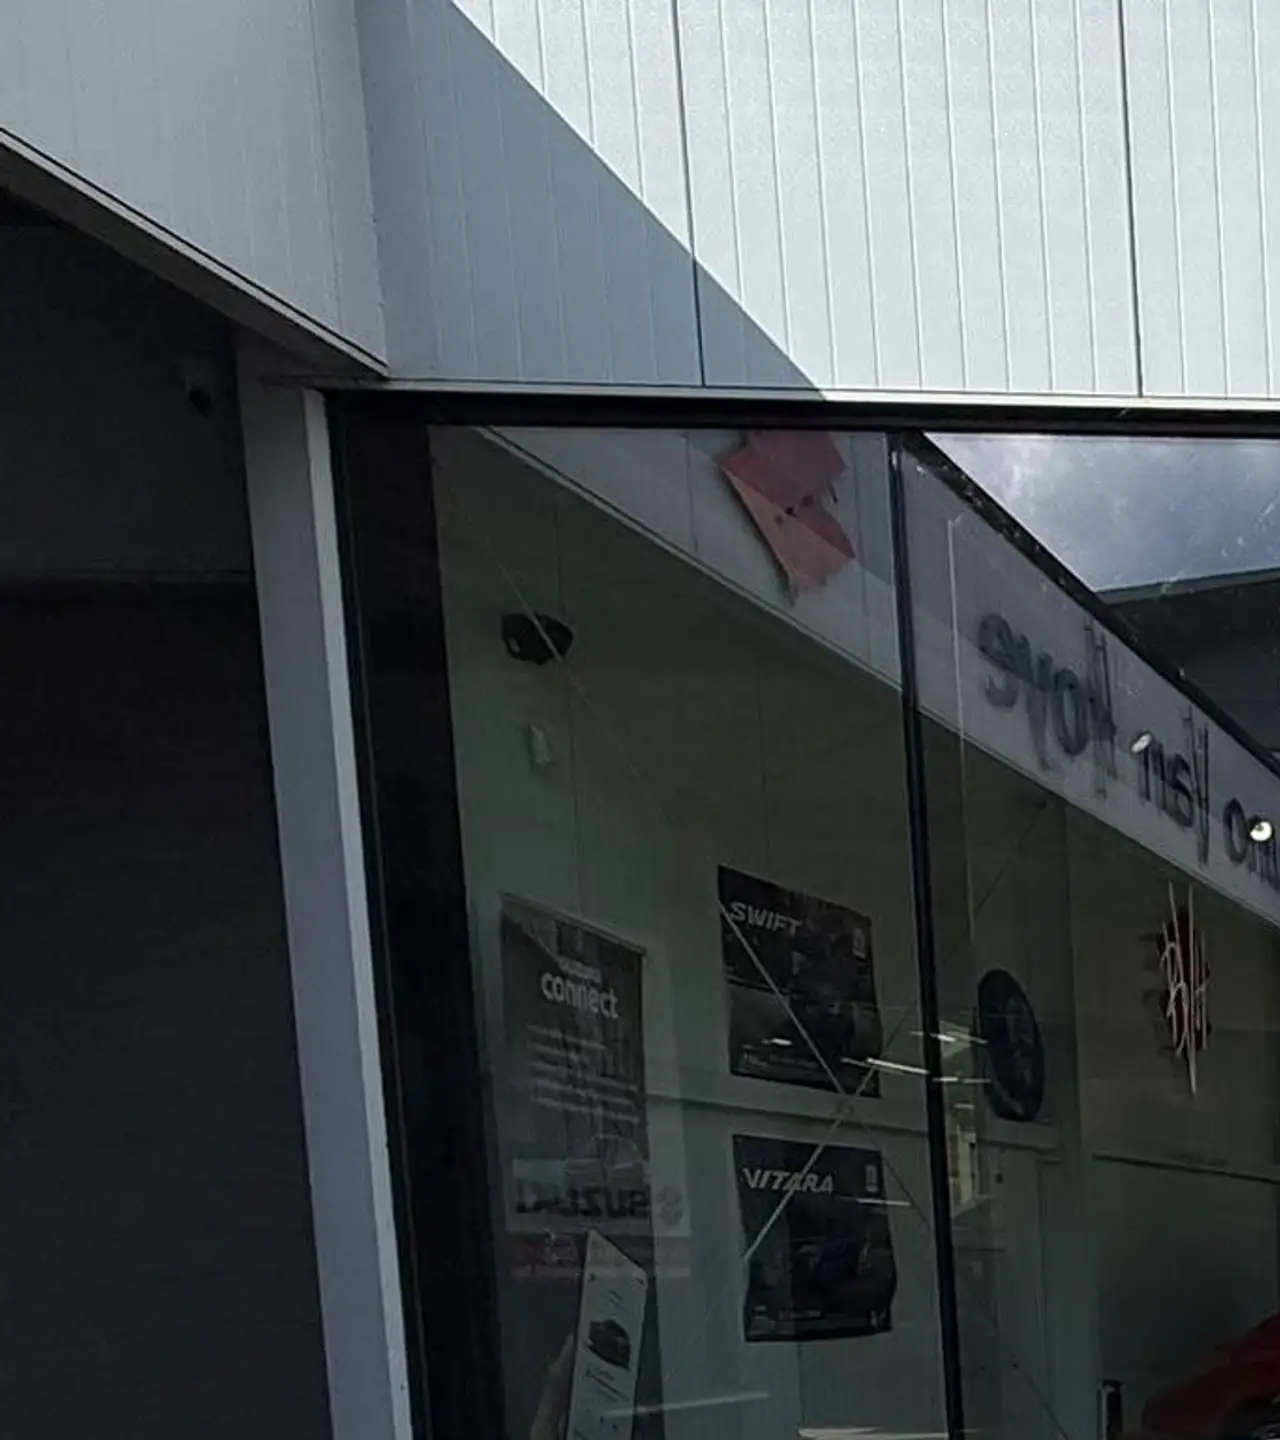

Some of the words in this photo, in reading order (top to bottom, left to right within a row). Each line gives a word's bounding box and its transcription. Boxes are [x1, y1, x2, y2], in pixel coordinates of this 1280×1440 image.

[729, 899, 804, 937] SWIFT
[540, 971, 619, 1020] connect
[741, 1167, 834, 1195] VITARA
